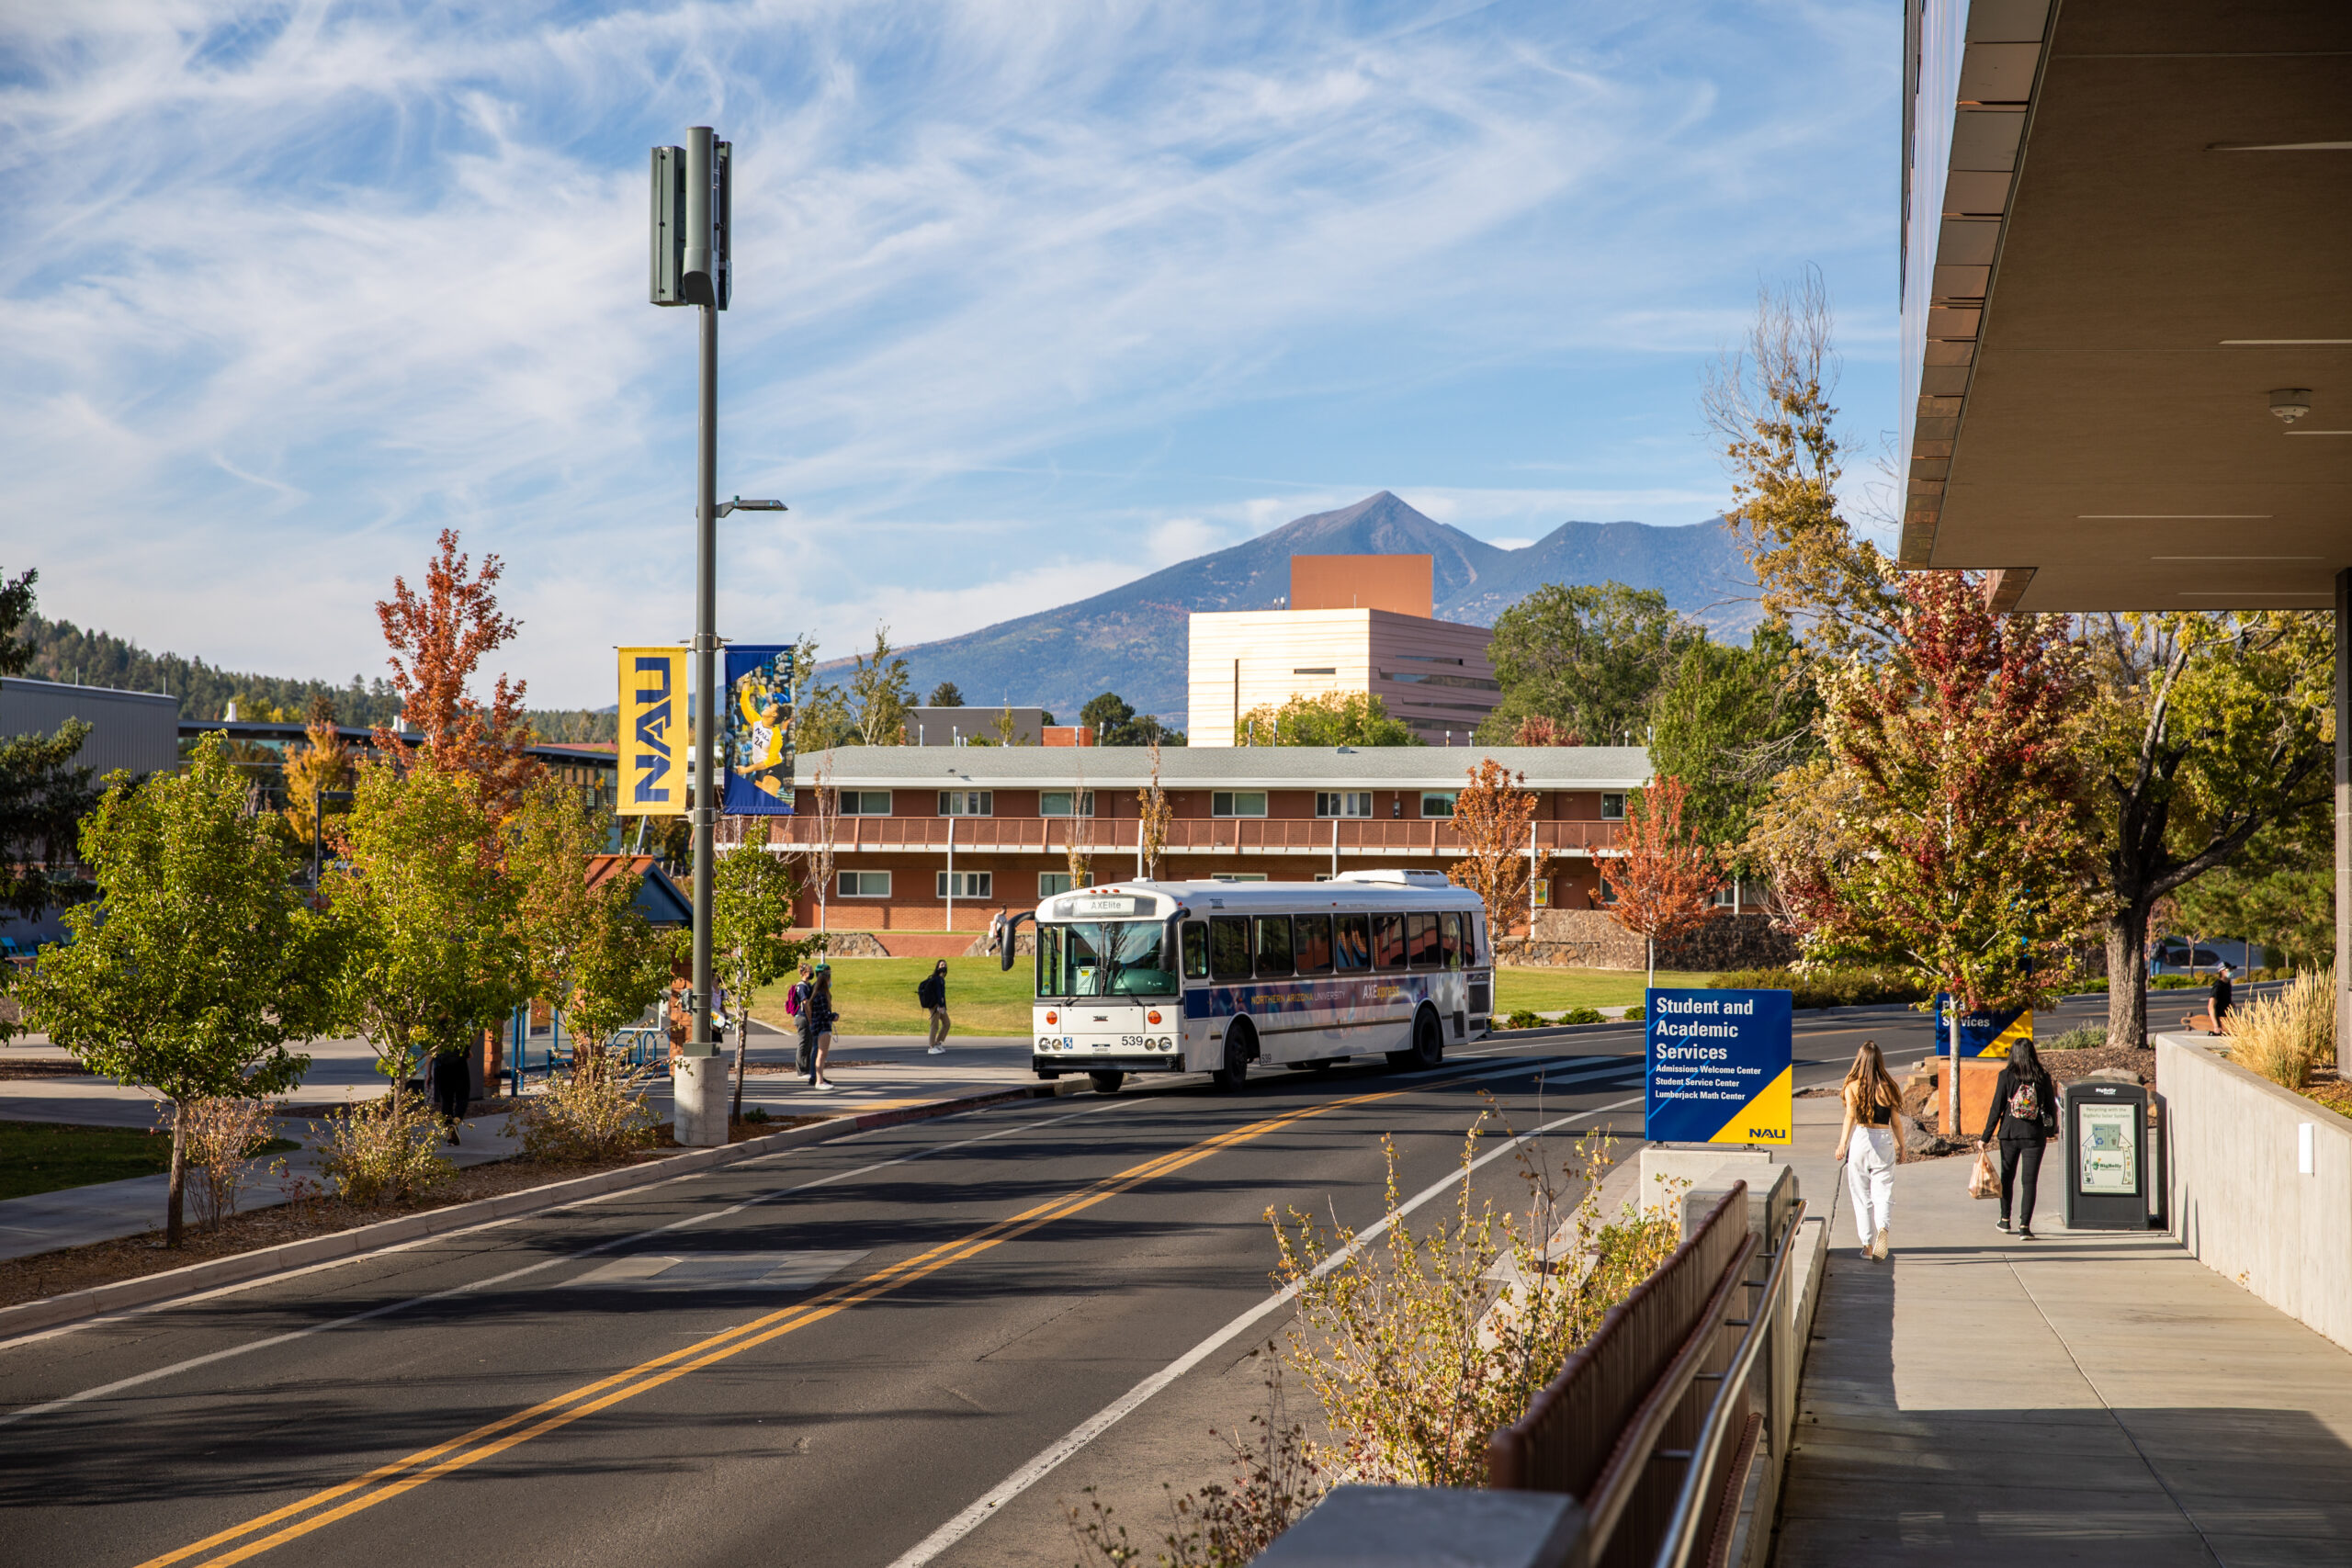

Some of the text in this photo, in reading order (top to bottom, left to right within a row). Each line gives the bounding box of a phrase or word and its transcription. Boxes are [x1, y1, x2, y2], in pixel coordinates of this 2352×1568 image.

[634, 657, 672, 805] NAU
[754, 737, 763, 749] 24
[1091, 901, 1121, 909] AXElite
[1251, 990, 1346, 1005] NORTHERN ARIZONA UNIVERSITY
[1363, 984, 1400, 1001] AXExpress
[1657, 997, 1753, 1015] Student and
[1942, 1016, 1990, 1027] Svices
[1656, 1020, 1738, 1038] Academic
[1121, 1036, 1143, 1046] 539
[1656, 1043, 1727, 1060] Services
[1261, 1054, 1272, 1064] 539
[1656, 1065, 1761, 1075] Admissions Welcome Center
[1656, 1077, 1739, 1087] Student Service Center
[1656, 1090, 1745, 1100] Lumberjack Math Center
[1749, 1128, 1785, 1138] NAU
